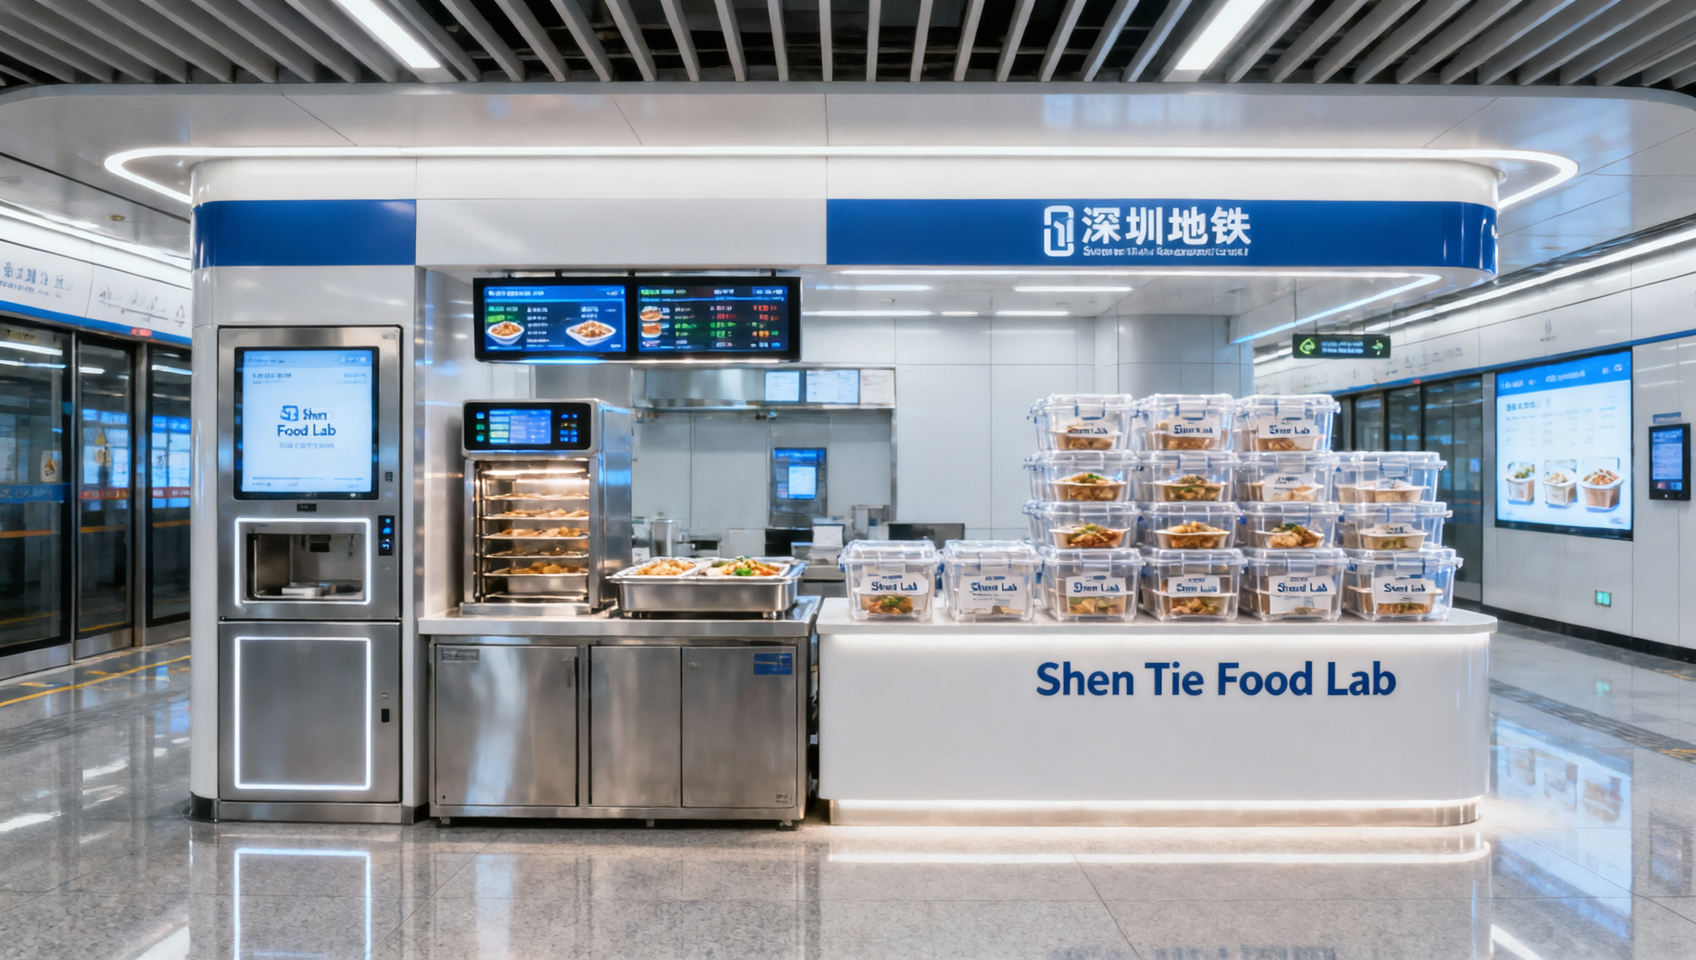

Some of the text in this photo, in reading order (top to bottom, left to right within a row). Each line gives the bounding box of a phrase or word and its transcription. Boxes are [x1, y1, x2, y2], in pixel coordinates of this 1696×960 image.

[1081, 206, 1252, 245] 深圳地铁
[277, 423, 337, 437] Food Lab
[1036, 661, 1397, 697] Shen Tie Food Lab
